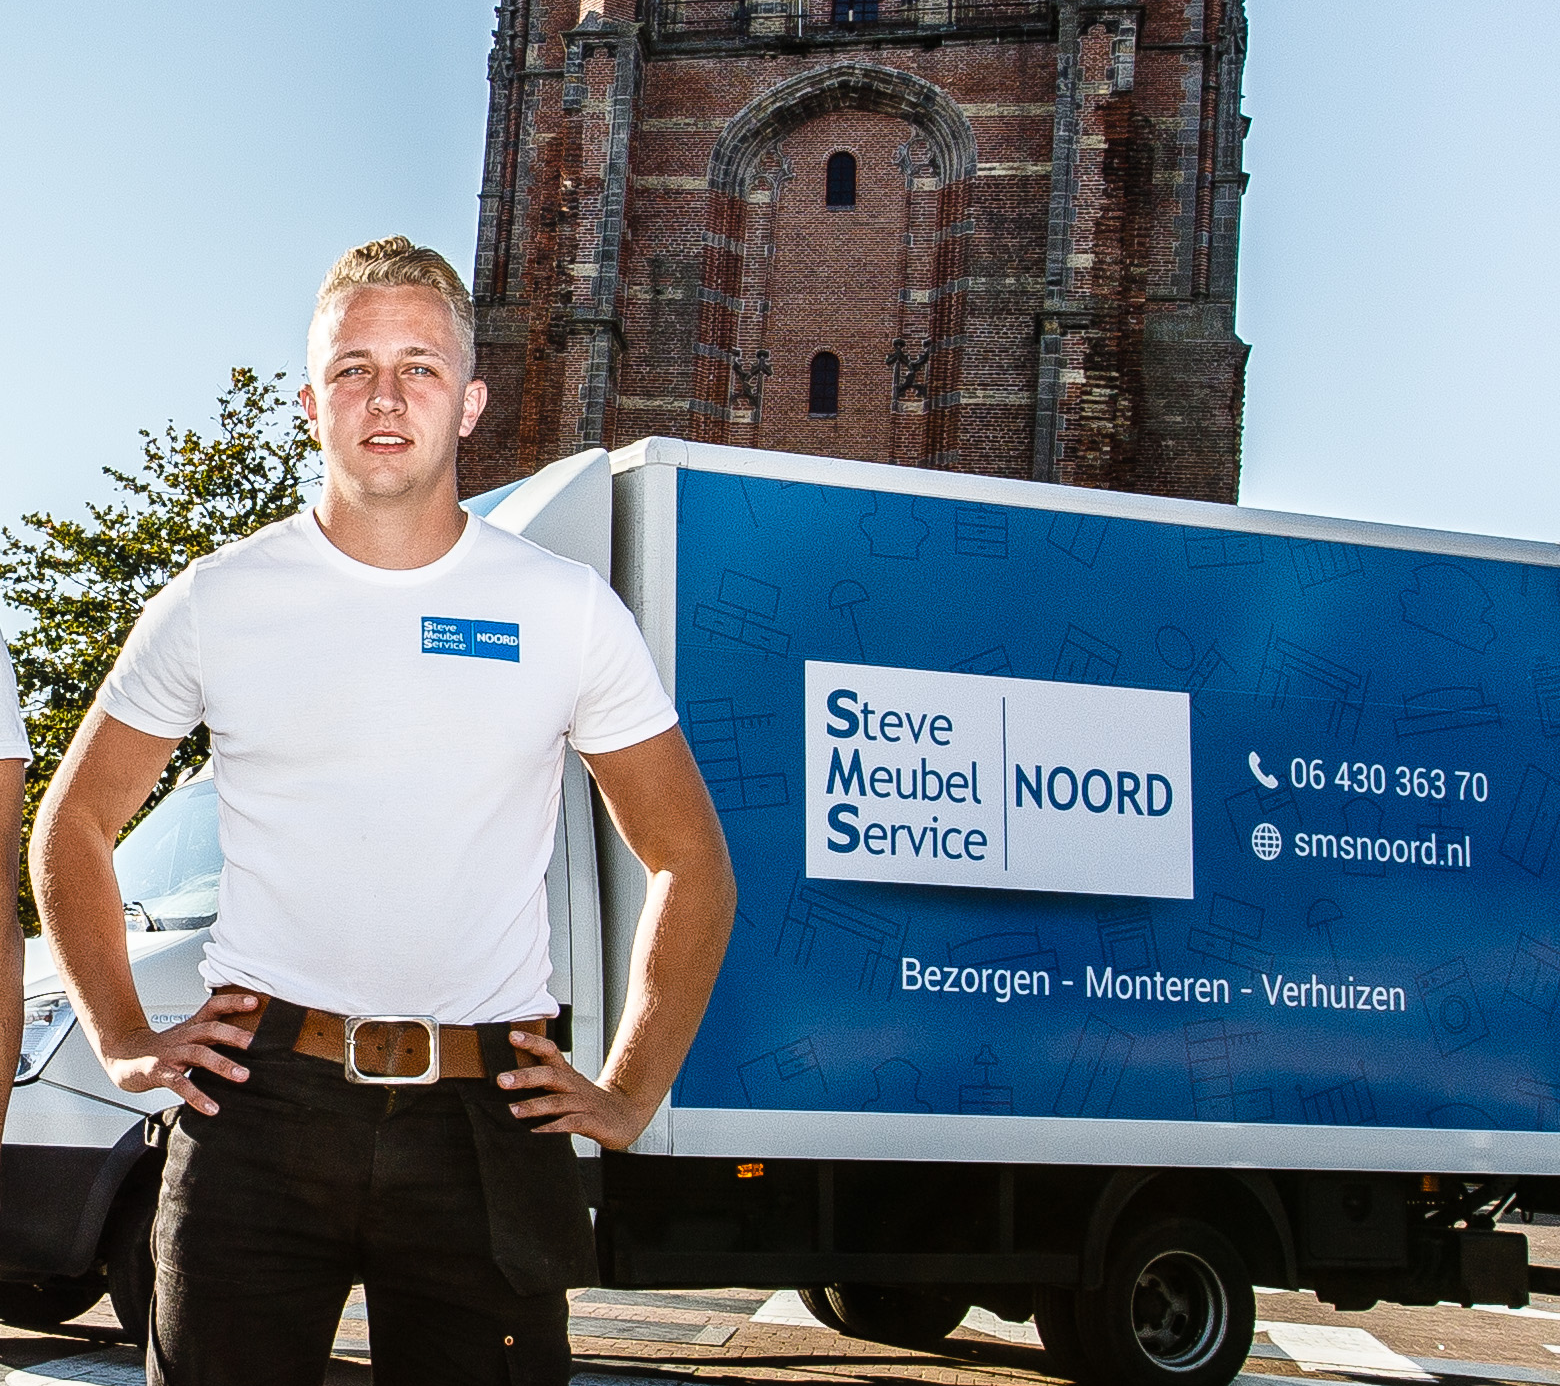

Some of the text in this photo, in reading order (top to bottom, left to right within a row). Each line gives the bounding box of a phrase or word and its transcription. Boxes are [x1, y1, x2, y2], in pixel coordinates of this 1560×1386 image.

[424, 621, 457, 632] Steve
[424, 631, 463, 642] Meubel
[424, 639, 466, 650] Service
[476, 633, 518, 646] NOORD
[826, 688, 953, 746] Steve
[826, 747, 982, 805] Meubel
[1015, 763, 1173, 817] NOORD
[1290, 757, 1488, 802] 06 430 363 70
[826, 803, 988, 861] Service
[1294, 832, 1471, 867] smsnoord.nl
[900, 957, 1050, 1003] Bezorgen
[1085, 965, 1230, 1004] Monteren
[1262, 973, 1406, 1012] Verhuizen
